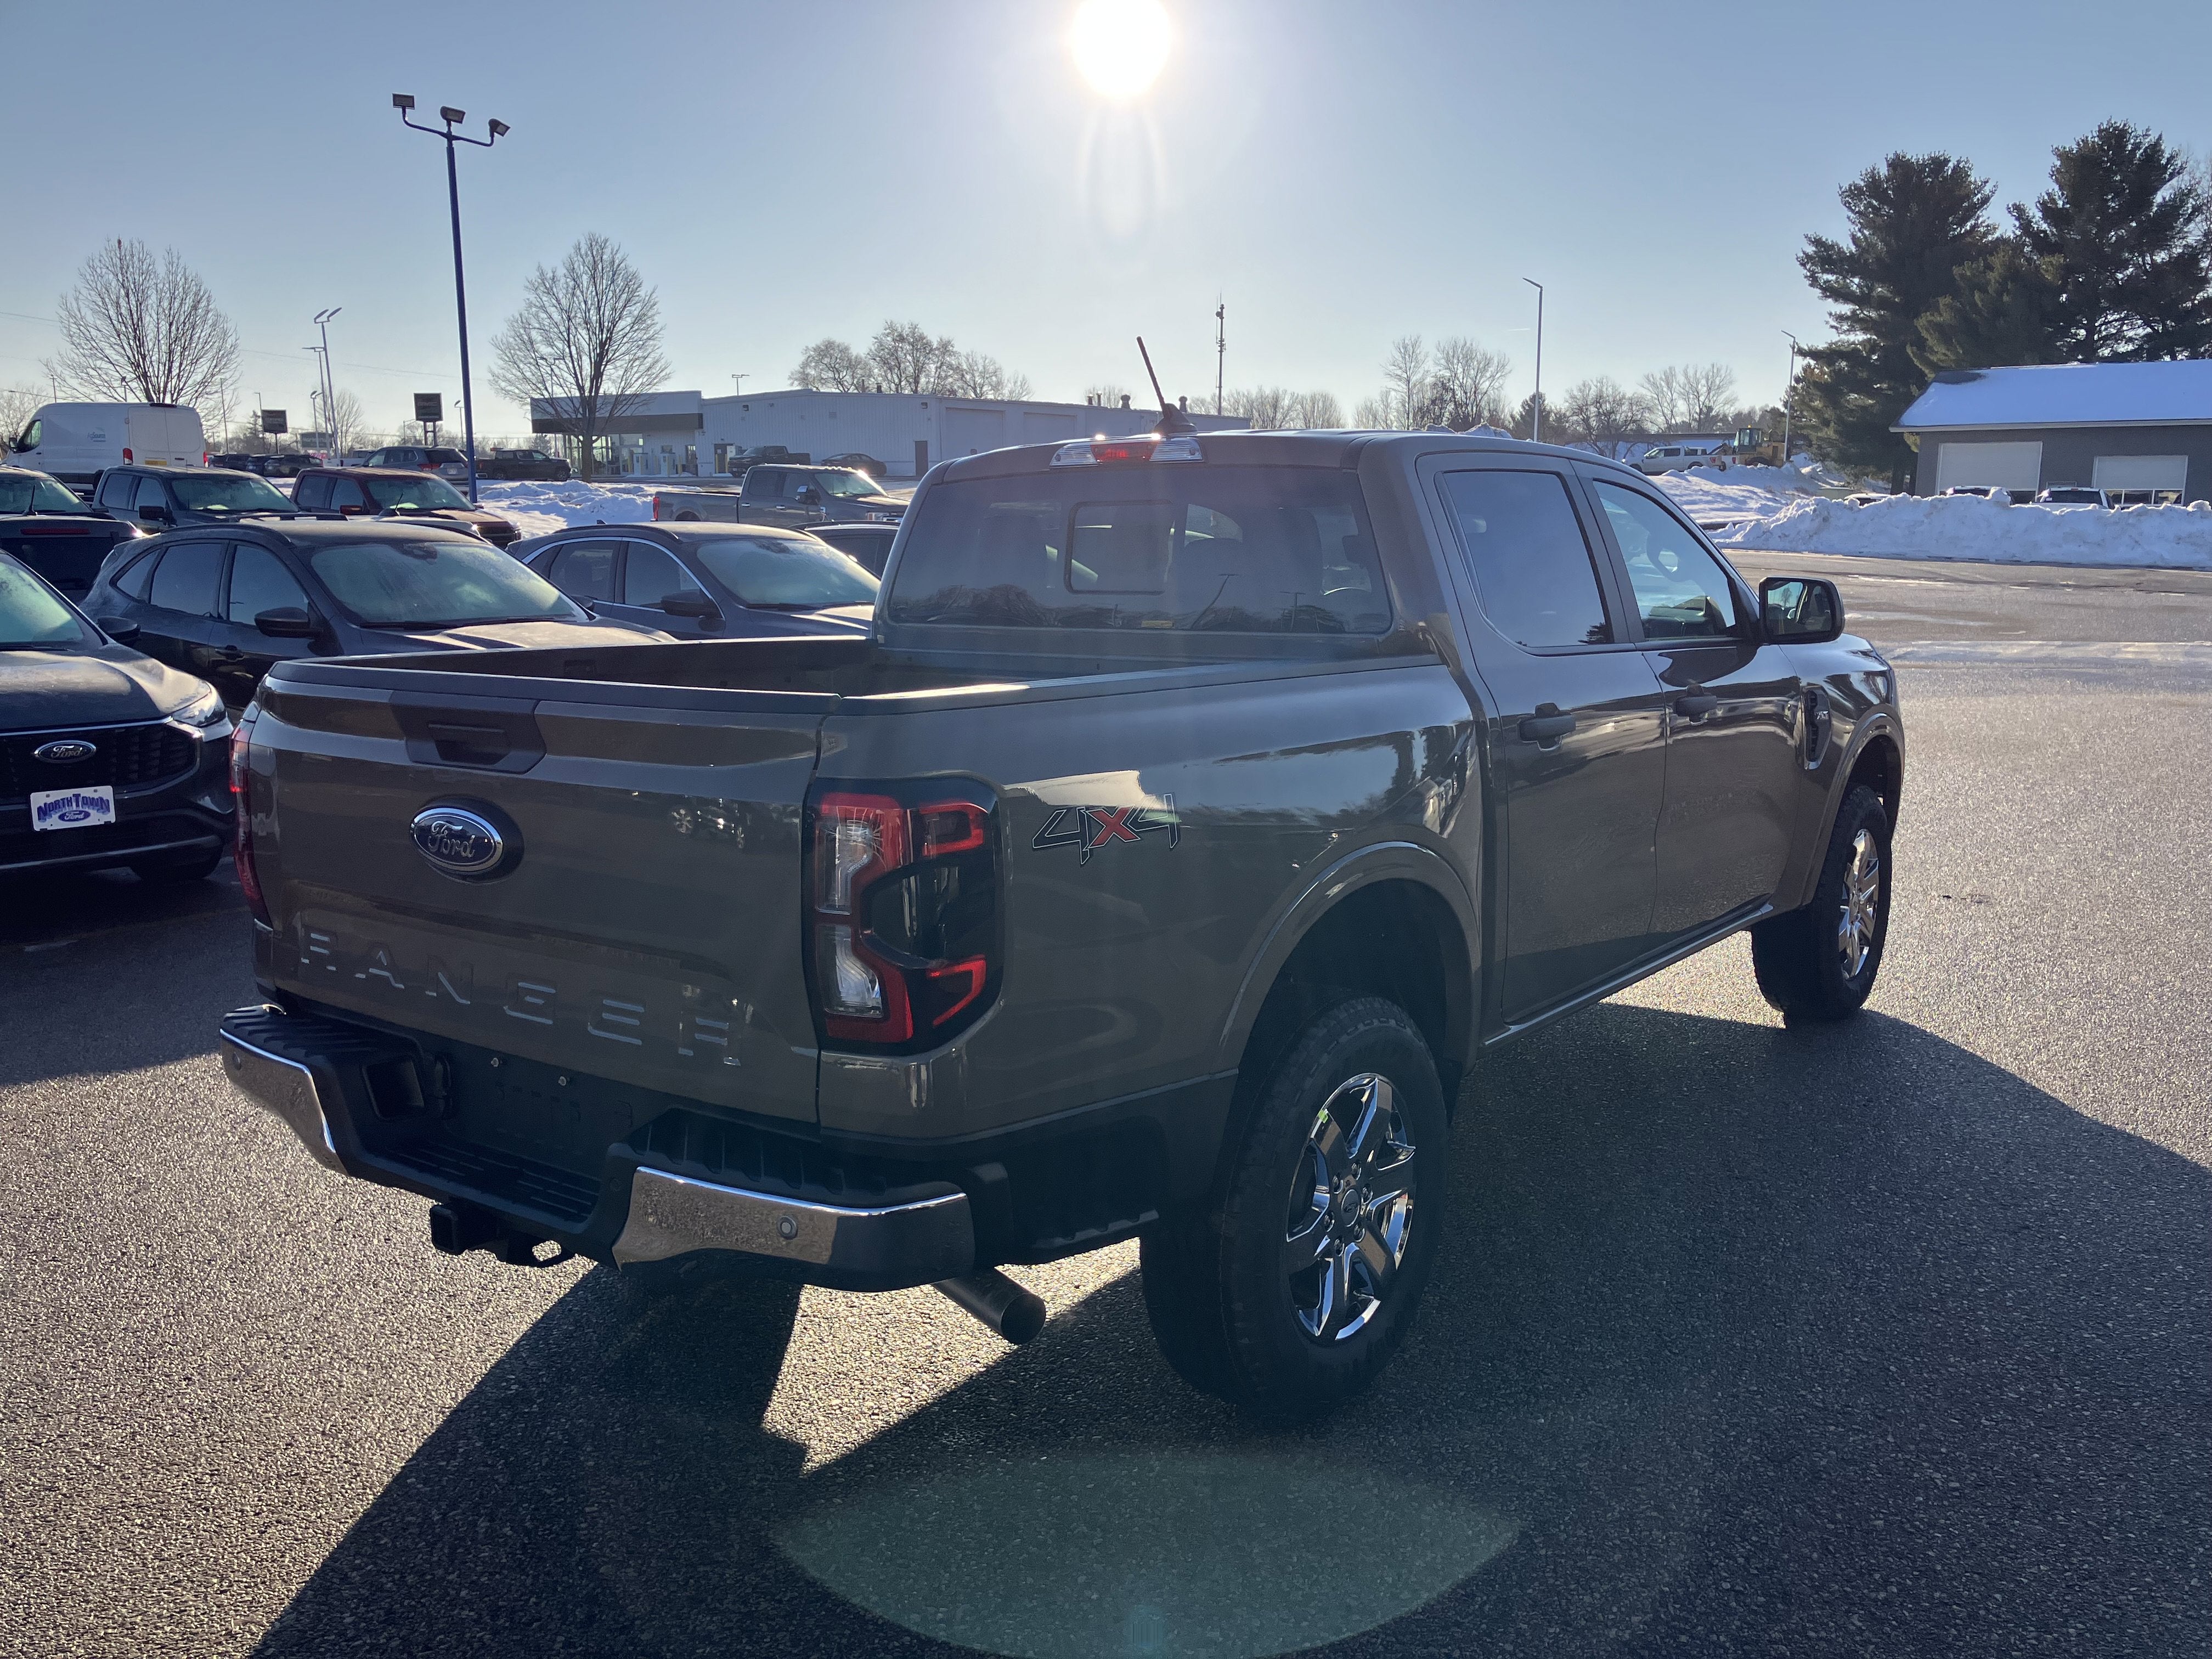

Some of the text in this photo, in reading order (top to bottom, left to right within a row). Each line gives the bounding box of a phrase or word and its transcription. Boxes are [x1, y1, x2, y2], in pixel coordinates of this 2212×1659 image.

[50, 745, 83, 758] Ford
[64, 811, 85, 820] Ford
[428, 821, 476, 858] Ford
[300, 928, 742, 1066] RANGER
